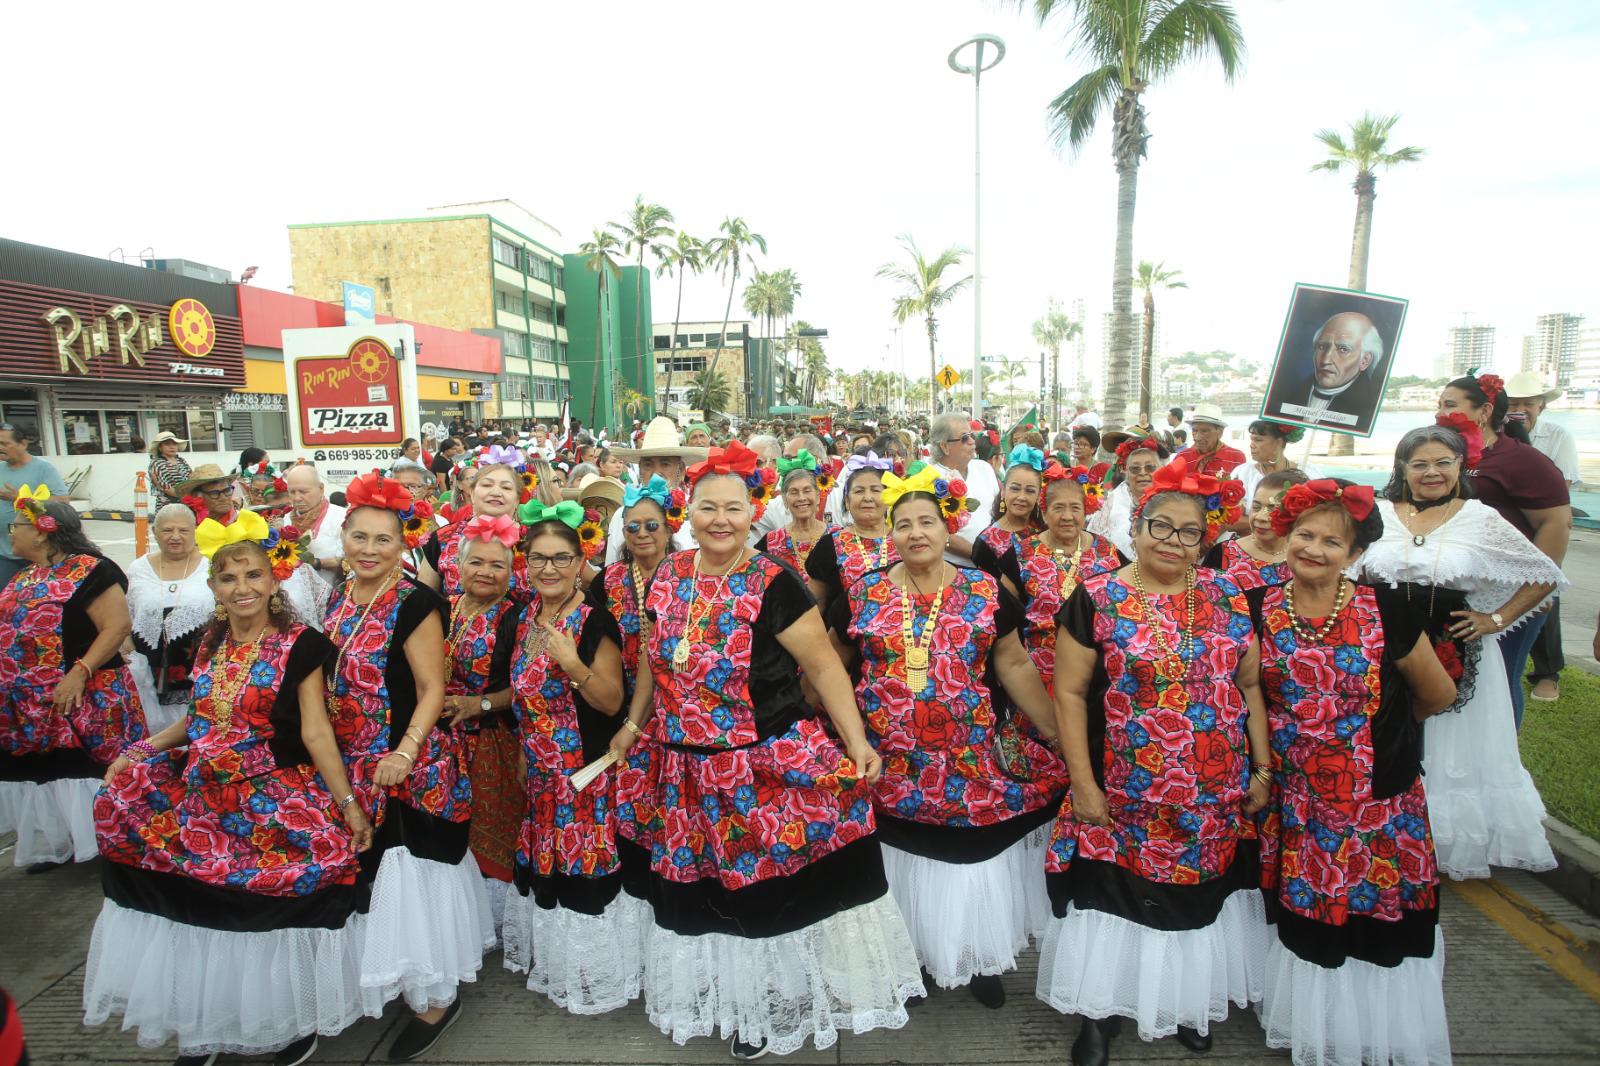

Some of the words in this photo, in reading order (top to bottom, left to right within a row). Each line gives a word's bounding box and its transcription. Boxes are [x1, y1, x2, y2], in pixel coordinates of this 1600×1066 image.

[168, 362, 224, 376] Pizza
[224, 393, 240, 404] 669
[243, 394, 258, 404] 985
[260, 394, 271, 404] 20
[273, 395, 283, 404] 87
[224, 403, 249, 411] SERVICIO
[313, 408, 388, 428] Pizza
[1296, 407, 1318, 417] Miguel
[1320, 411, 1346, 422] Hidalgo
